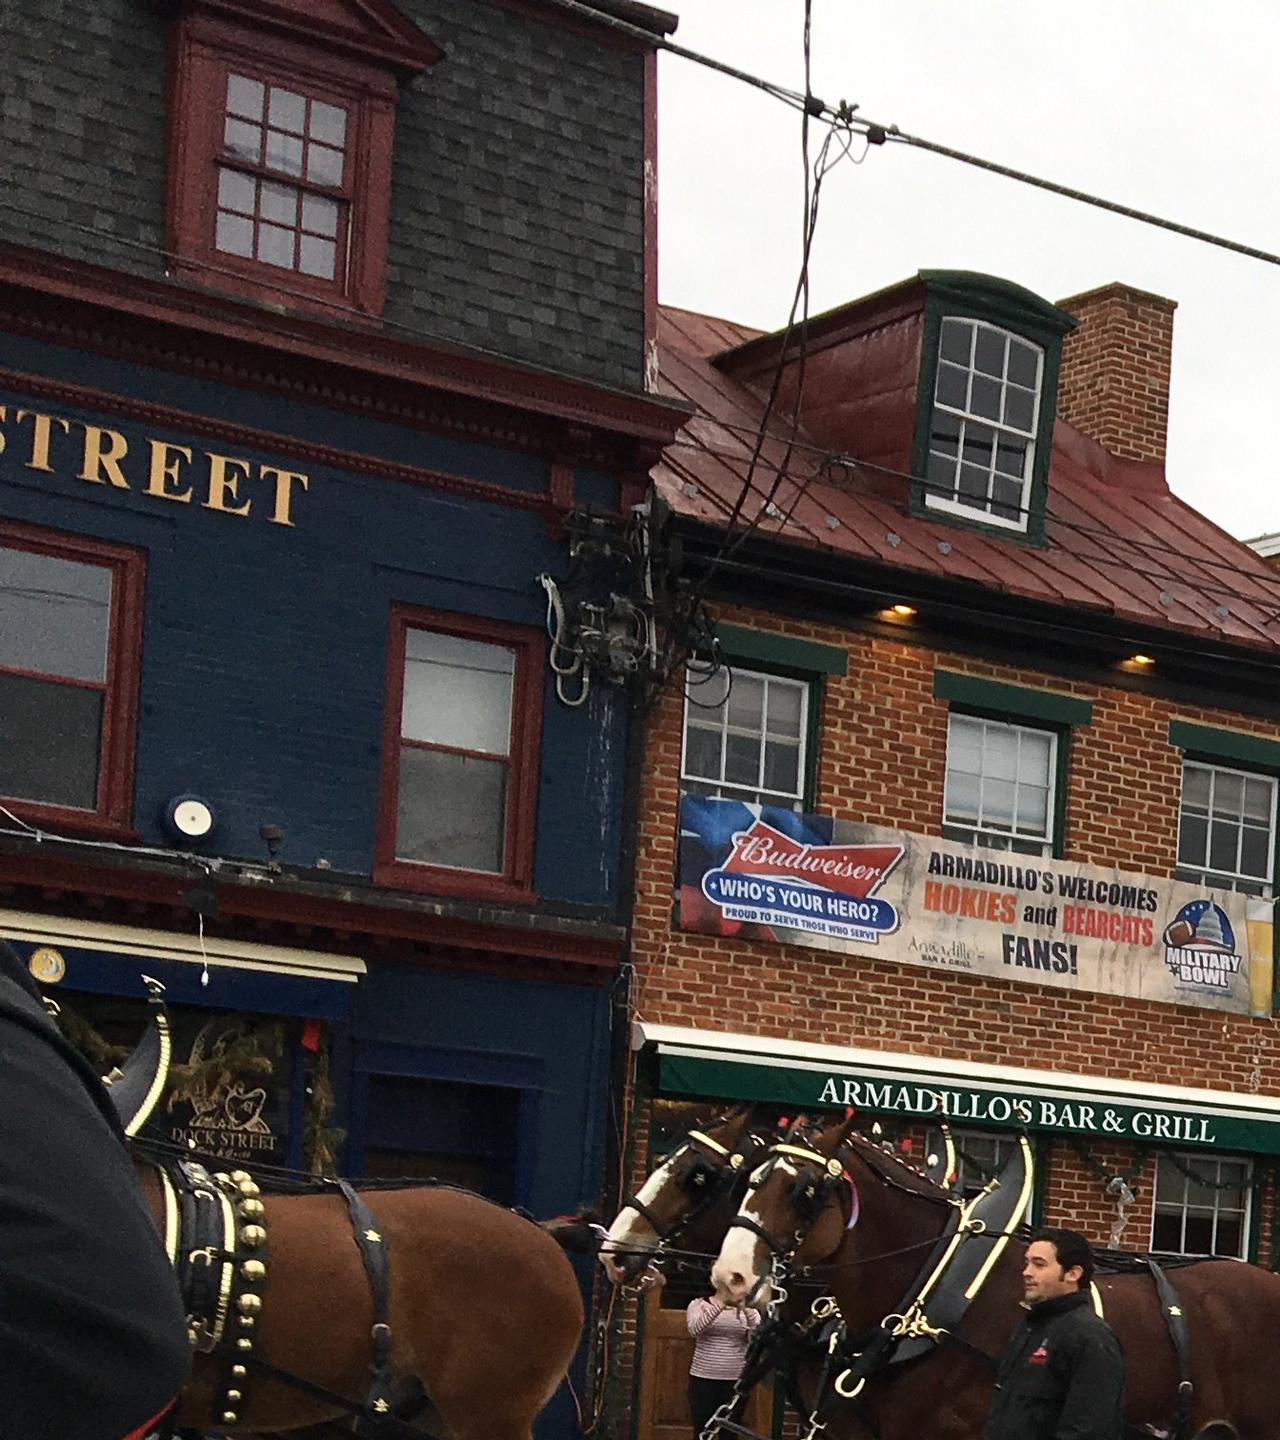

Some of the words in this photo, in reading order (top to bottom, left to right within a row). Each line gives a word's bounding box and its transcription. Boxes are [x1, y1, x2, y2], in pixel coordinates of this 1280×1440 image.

[0, 404, 309, 528] TREET
[736, 834, 881, 882] Budweiser
[719, 878, 776, 903] WHO'S
[779, 890, 824, 913] YOUR
[827, 898, 879, 921] HERO?
[928, 852, 1054, 895] ARMADILLO'S
[1058, 874, 1158, 913] WELCOMES
[725, 906, 757, 920] PROUD
[760, 911, 772, 922] TO
[774, 914, 800, 928] SERVE
[801, 919, 826, 932] THOSE
[829, 924, 848, 936] WHO
[850, 928, 875, 940] SERVE
[923, 880, 1018, 925] HOKIES
[1023, 904, 1058, 927] and
[1062, 904, 1153, 947] BEARCATS
[1002, 933, 1079, 975] FANS!
[1166, 946, 1241, 973] MILITARY
[1180, 965, 1228, 988] BOWL
[819, 1077, 1033, 1124] ARMADILLO'S
[1039, 1102, 1098, 1131] BAR
[1101, 1109, 1127, 1134] &
[1131, 1112, 1216, 1143] GRILL
[171, 1127, 216, 1146] DOCK
[220, 1132, 278, 1151] STREET
